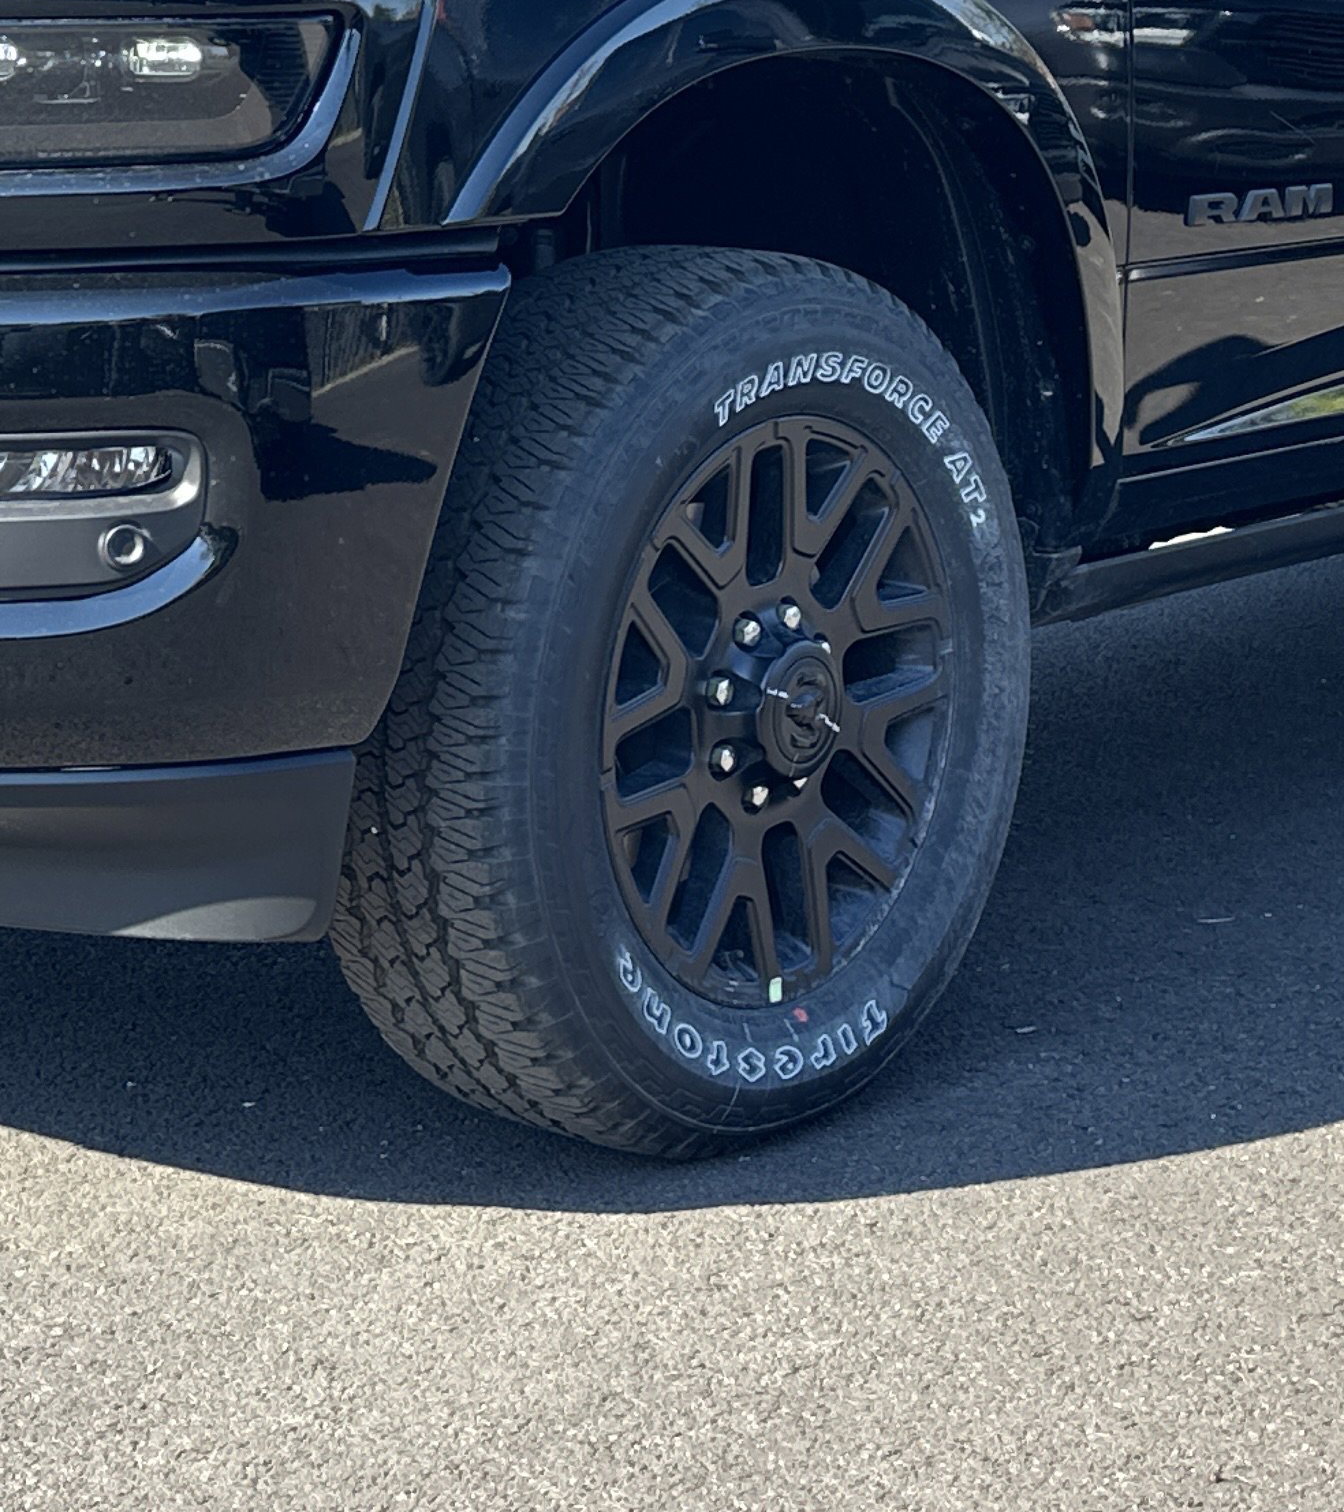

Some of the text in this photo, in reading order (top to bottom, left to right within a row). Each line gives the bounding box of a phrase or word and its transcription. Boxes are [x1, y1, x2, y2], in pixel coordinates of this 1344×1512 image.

[1184, 182, 1334, 227] RAM
[713, 350, 951, 445] TRANSFORCE
[616, 945, 888, 1083] Firestone
